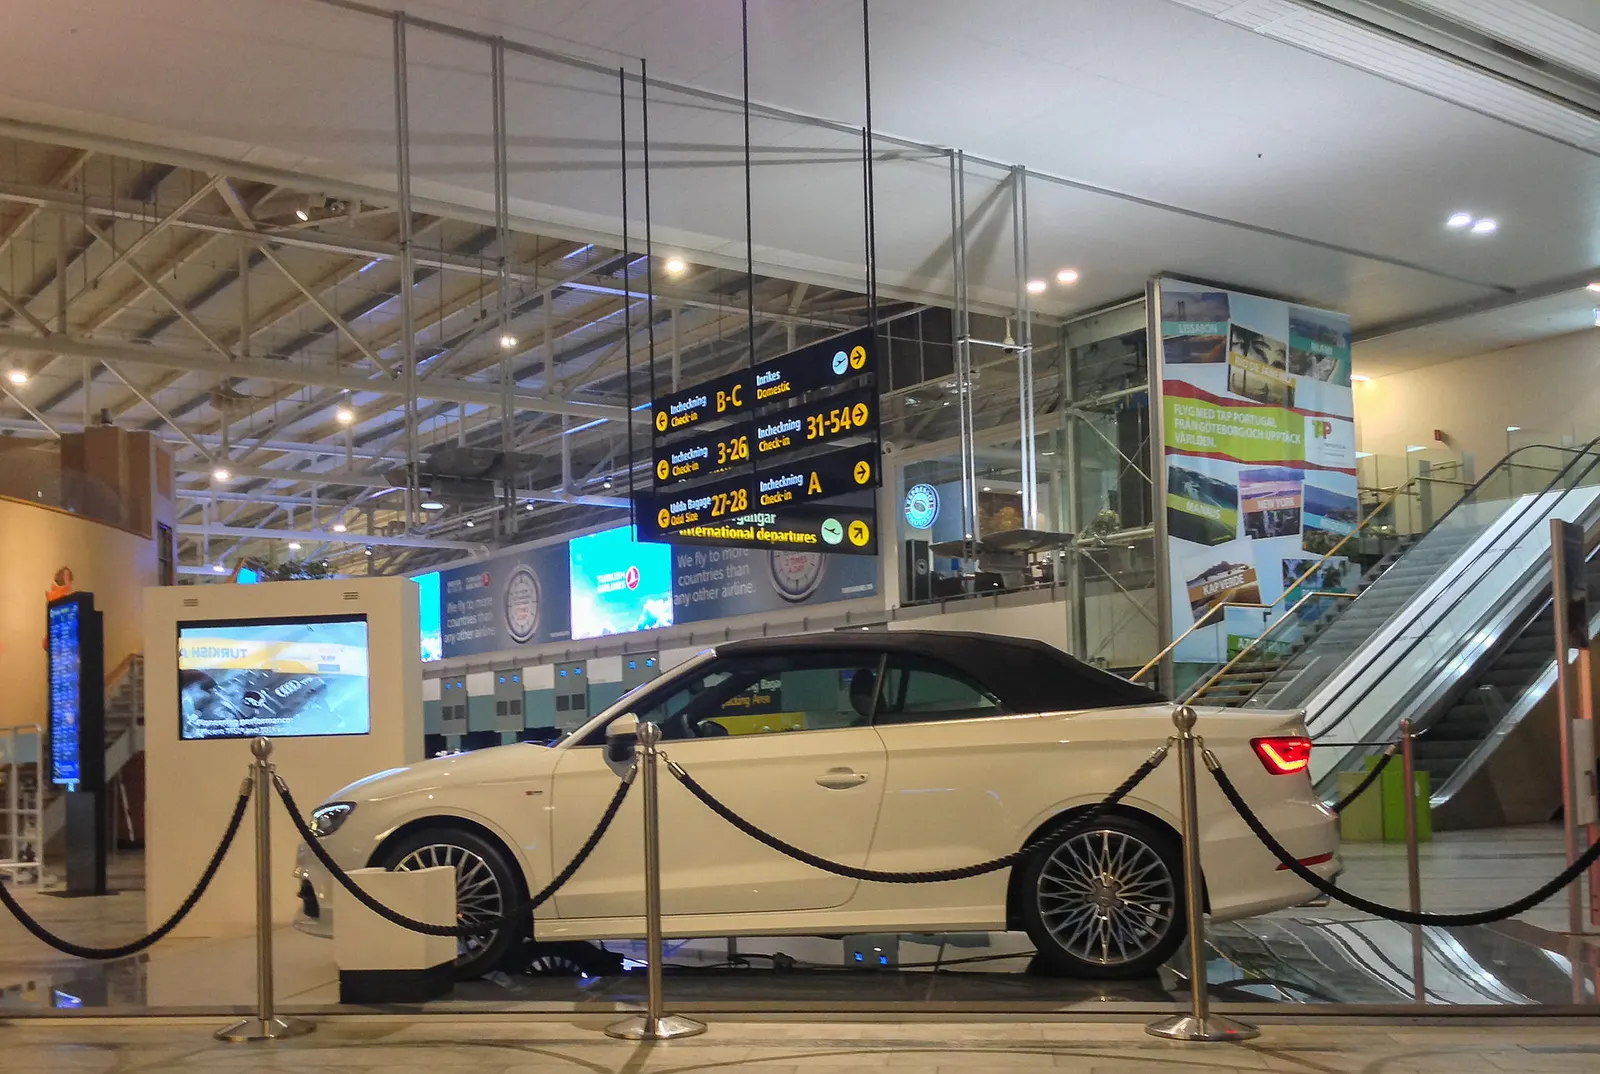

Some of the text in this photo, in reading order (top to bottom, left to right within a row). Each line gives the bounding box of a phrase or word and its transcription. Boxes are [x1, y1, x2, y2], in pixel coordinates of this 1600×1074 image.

[1178, 323, 1218, 334] LISSABON
[756, 370, 782, 387] Inrikes
[716, 384, 743, 413] B-C
[757, 381, 792, 400] Domestic
[670, 395, 708, 416] Incheckning
[1196, 407, 1216, 420] MED
[671, 411, 699, 428] Check-in
[757, 417, 802, 440] Incheckning
[805, 406, 851, 440] 31-54
[717, 435, 749, 465] 3-26
[758, 435, 791, 453] Check-in
[671, 446, 709, 465] Incheckning
[672, 461, 700, 476] Check-in
[759, 473, 804, 493] Incheckning
[807, 471, 823, 496] A
[687, 496, 712, 511] Bagage
[711, 488, 748, 517] 27-28
[760, 490, 793, 507] Check-in
[1256, 496, 1295, 510] NEW YORK
[670, 512, 699, 526] Odd Size
[756, 527, 818, 544] departures
[677, 547, 749, 569] We fly to more
[677, 563, 750, 587] countries than
[673, 580, 756, 607] any other airline.
[1202, 574, 1245, 596] KAP VERDE
